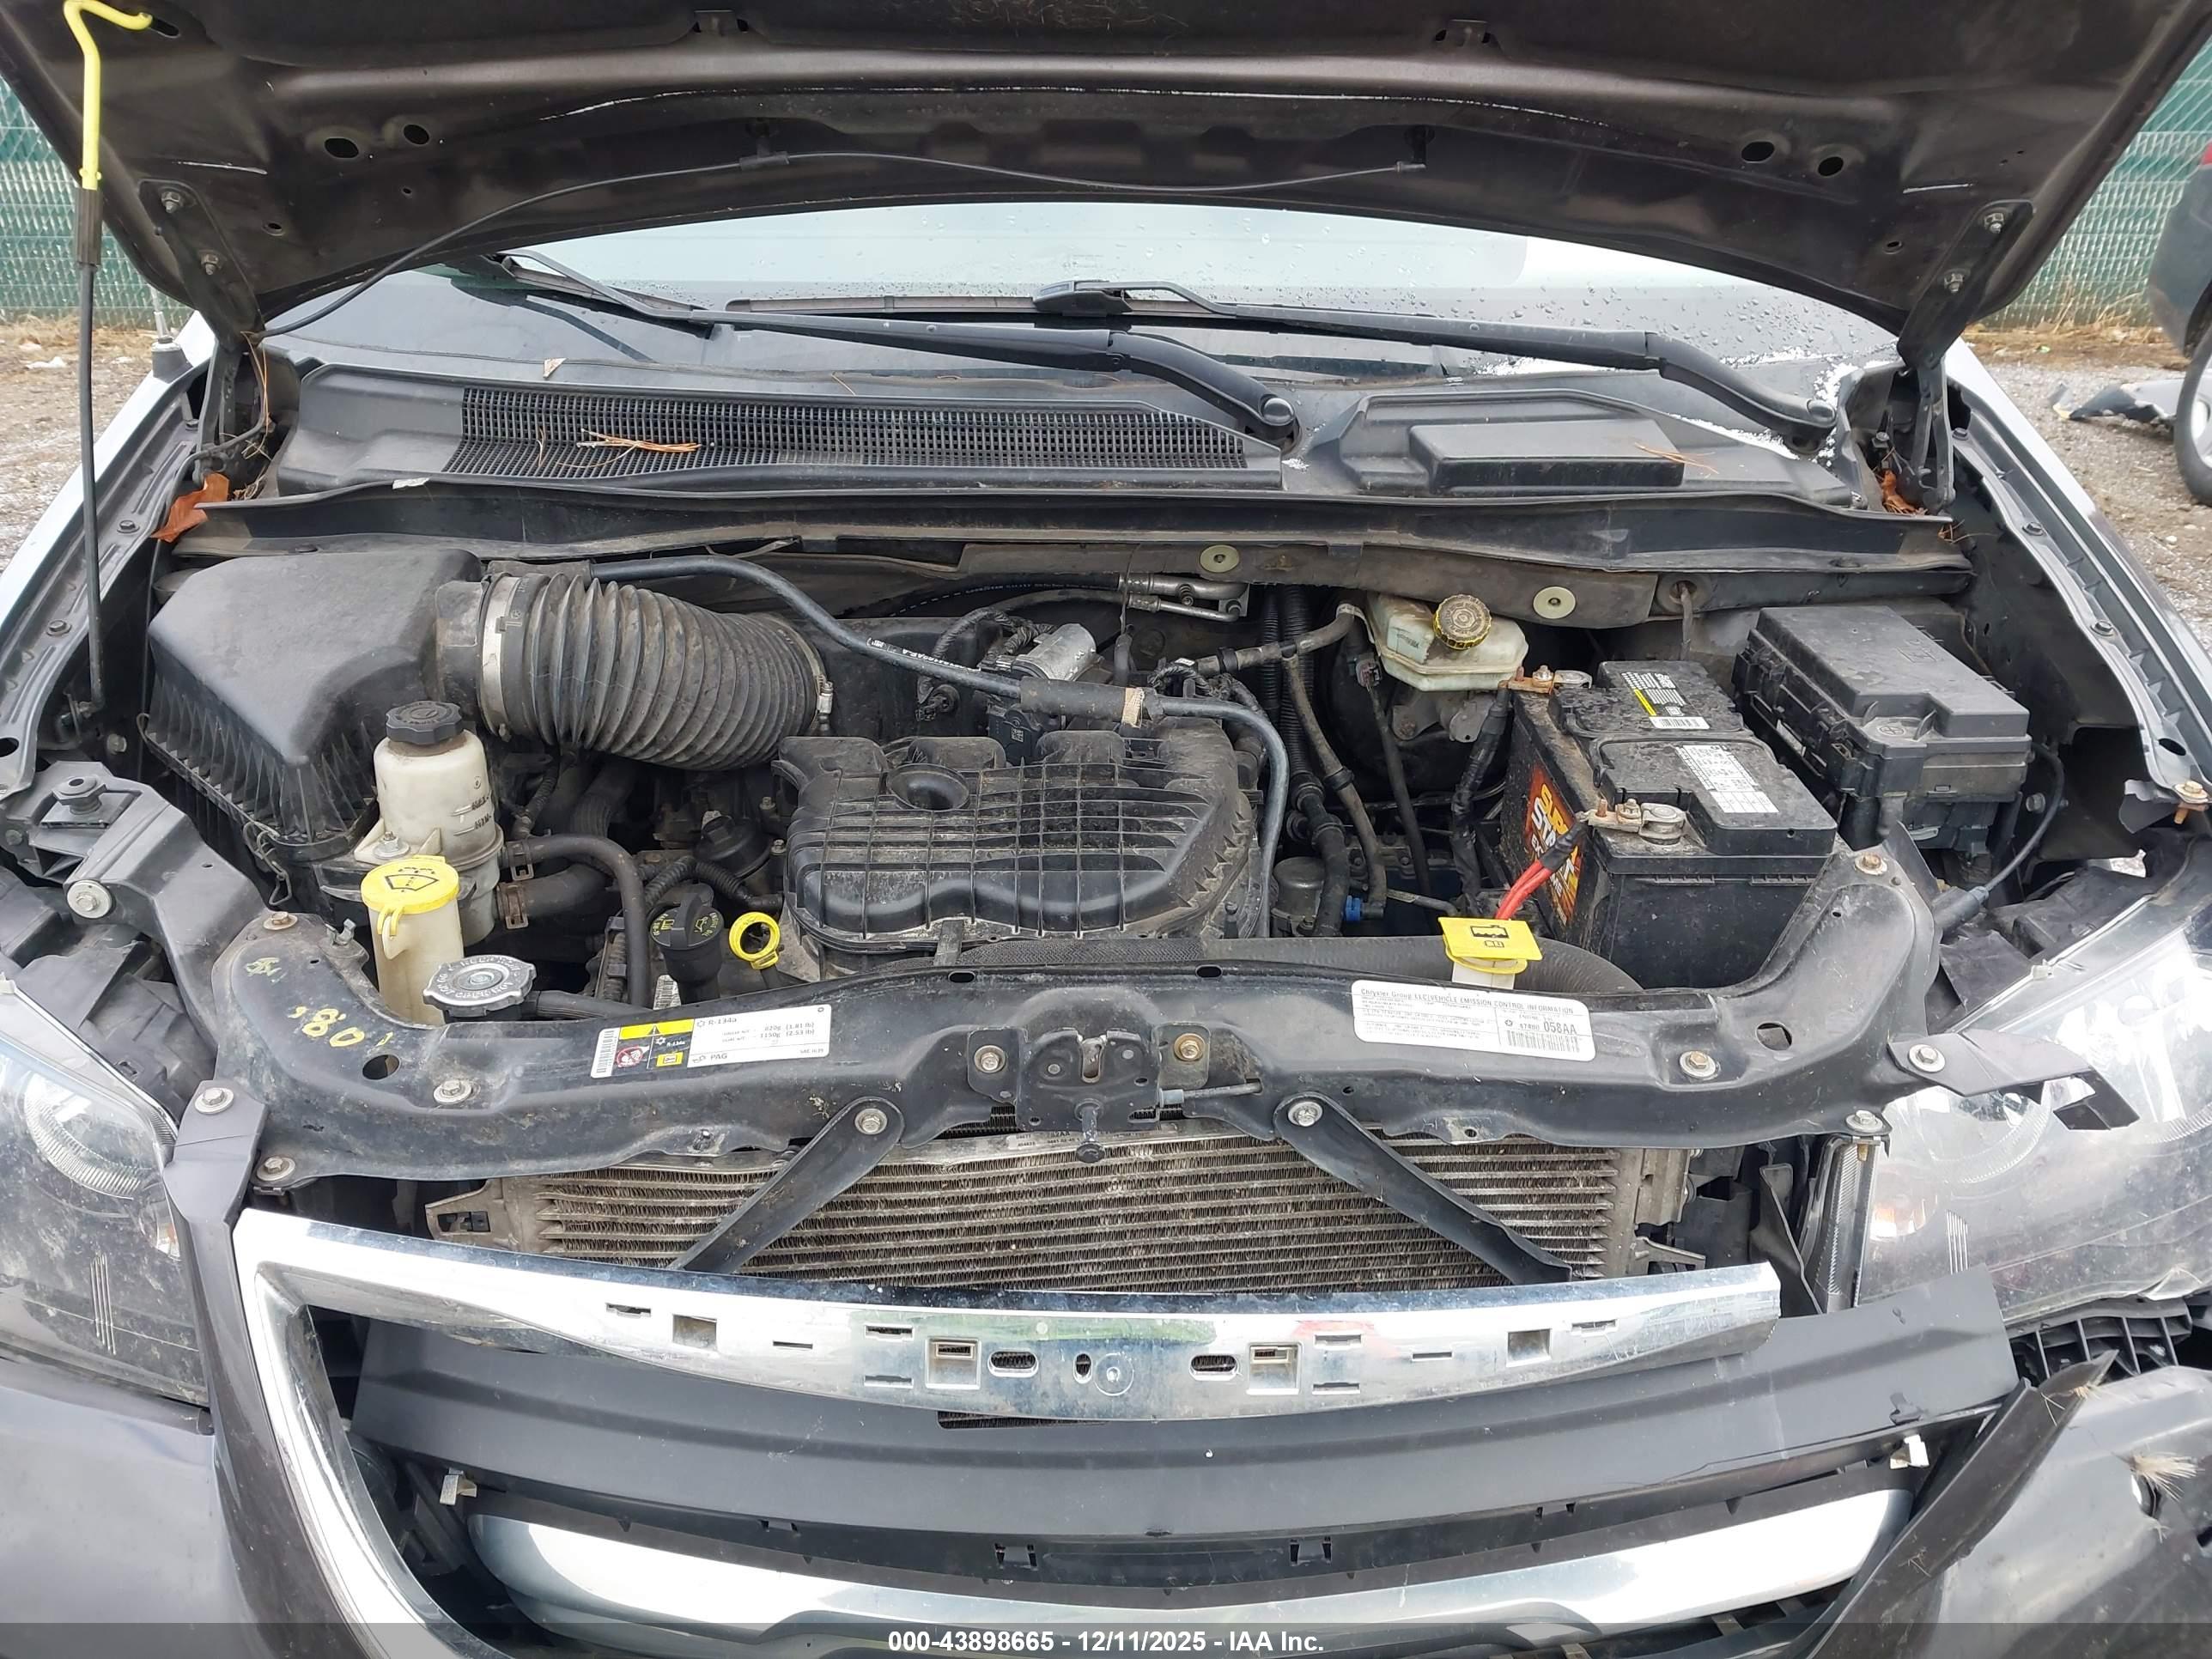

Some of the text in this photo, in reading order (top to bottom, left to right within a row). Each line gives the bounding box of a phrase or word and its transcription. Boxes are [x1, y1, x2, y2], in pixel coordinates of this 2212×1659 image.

[1360, 988, 1389, 997] Chrysler
[1391, 991, 1413, 1000] Group
[1430, 994, 1458, 1003] VEHICLE
[1460, 998, 1492, 1007] EMISSION
[1494, 1000, 1525, 1010] CONTROL
[1527, 1004, 1575, 1014] INFORMATION
[708, 1017, 738, 1026] R-134a
[1543, 1020, 1577, 1035] 058AA
